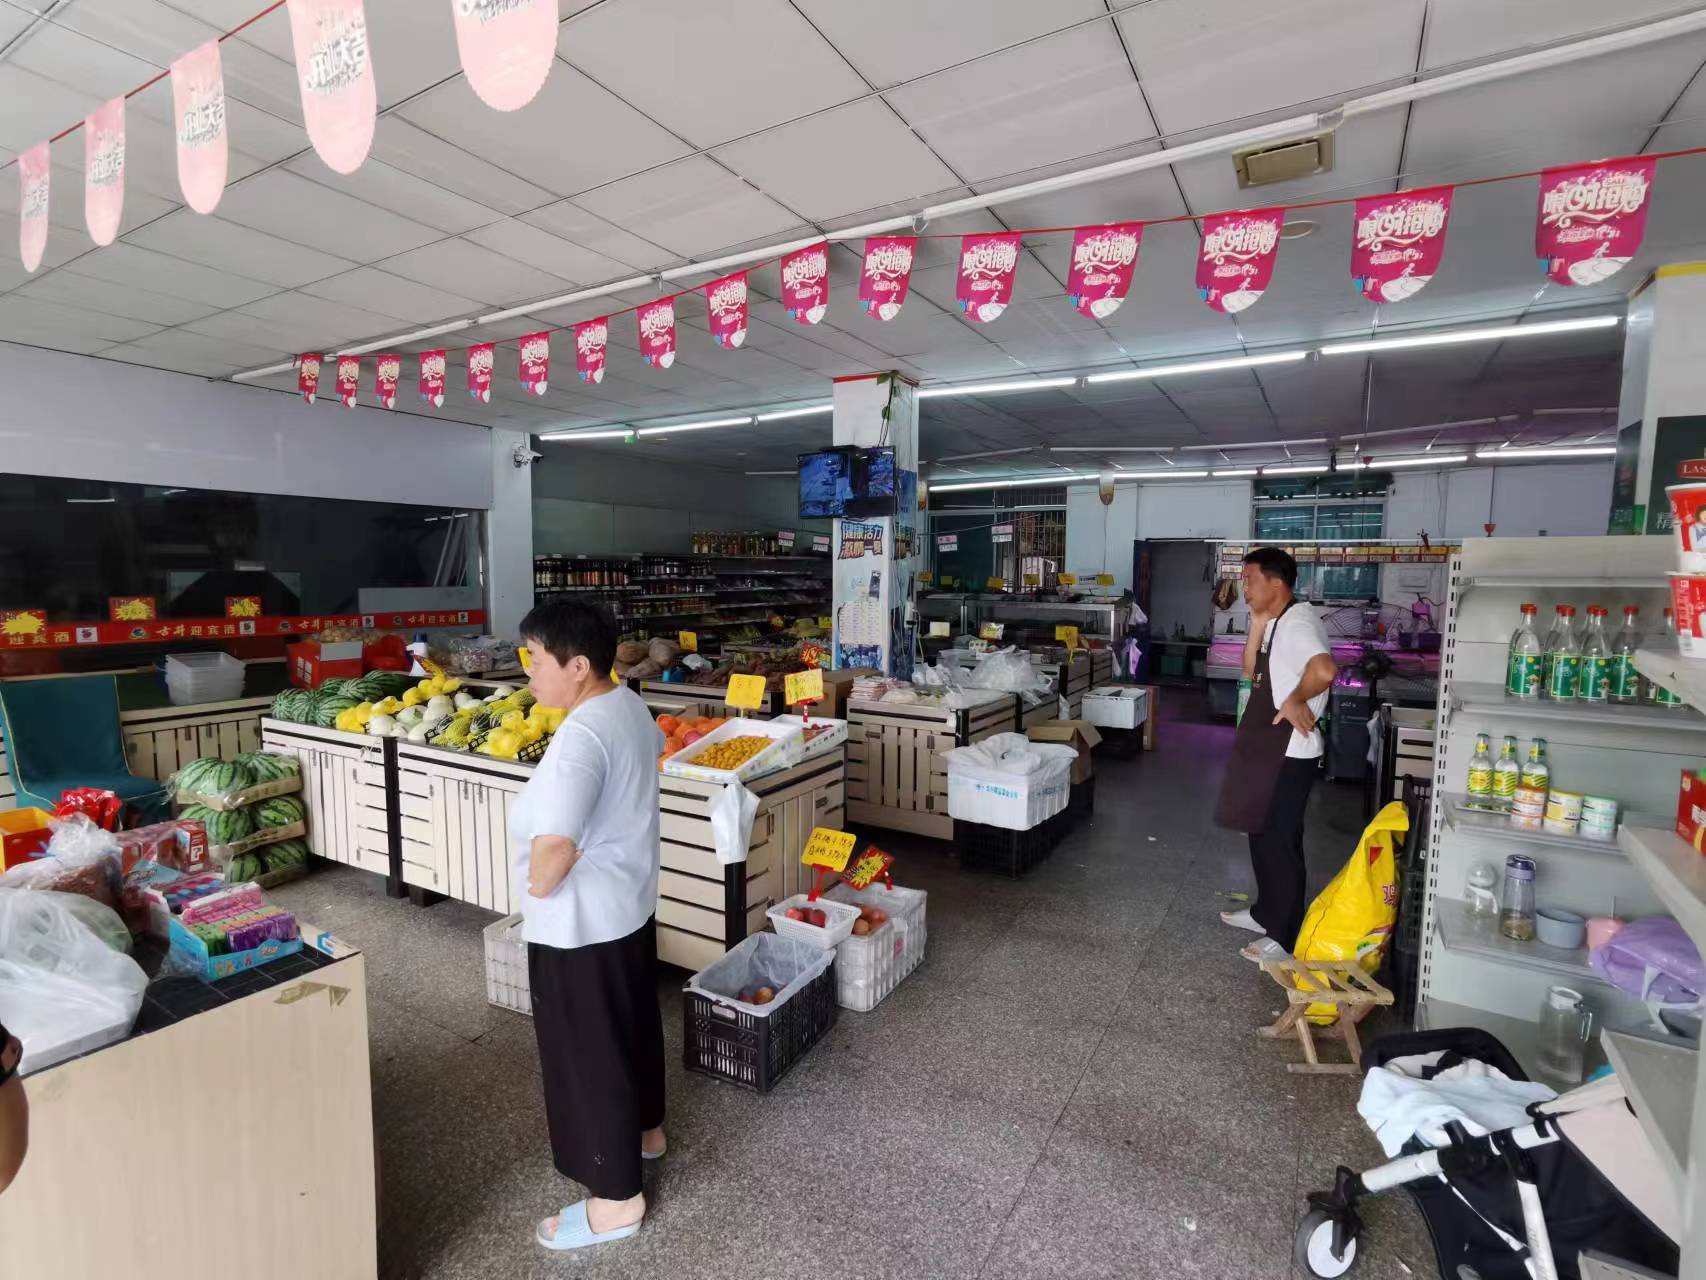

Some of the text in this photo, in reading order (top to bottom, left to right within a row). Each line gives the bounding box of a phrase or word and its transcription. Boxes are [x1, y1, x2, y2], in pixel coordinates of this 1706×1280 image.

[156, 624, 236, 637] 古井迎宾酒
